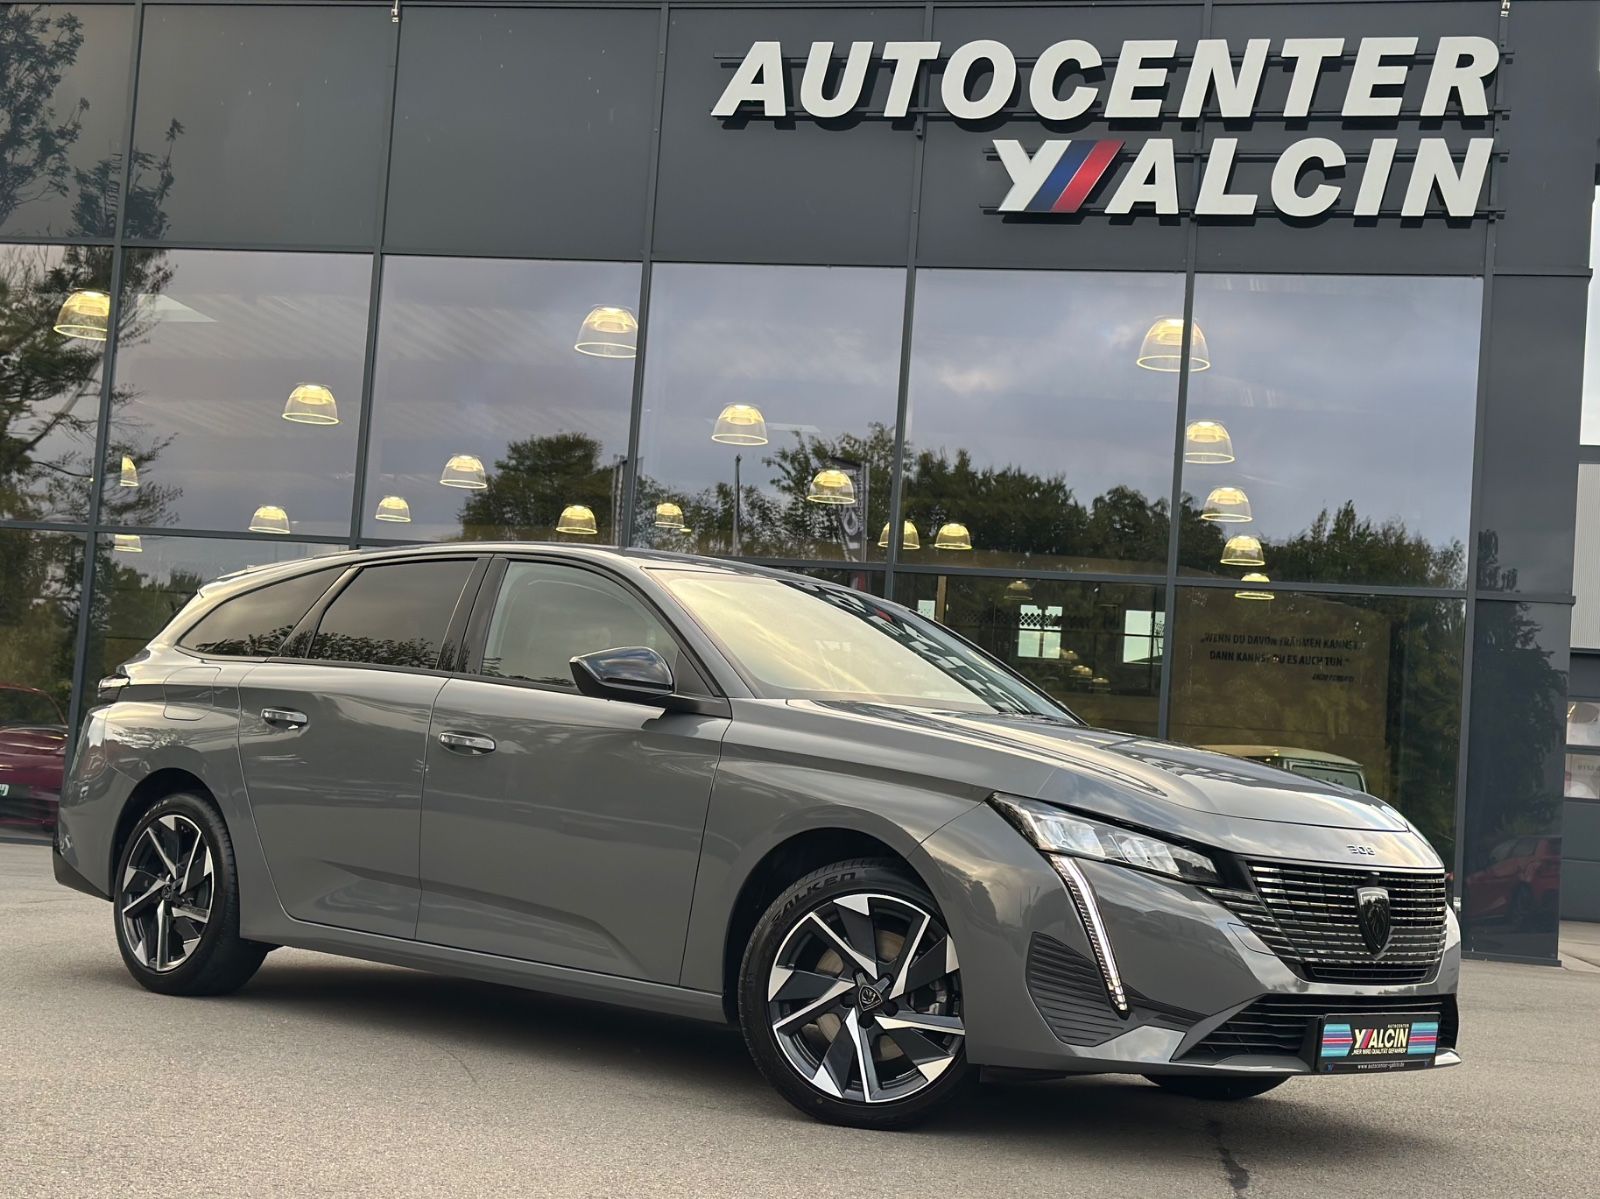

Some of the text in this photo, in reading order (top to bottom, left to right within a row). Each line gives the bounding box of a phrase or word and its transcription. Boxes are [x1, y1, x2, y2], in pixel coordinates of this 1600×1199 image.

[711, 36, 1500, 120] AUTOCENTER
[993, 137, 1494, 217] YALCIN
[1233, 634, 1246, 644] DU
[1209, 650, 1234, 661] DANN
[1287, 655, 1298, 665] ES
[1346, 844, 1376, 856] 308
[1354, 1029, 1408, 1048] YALCIN
